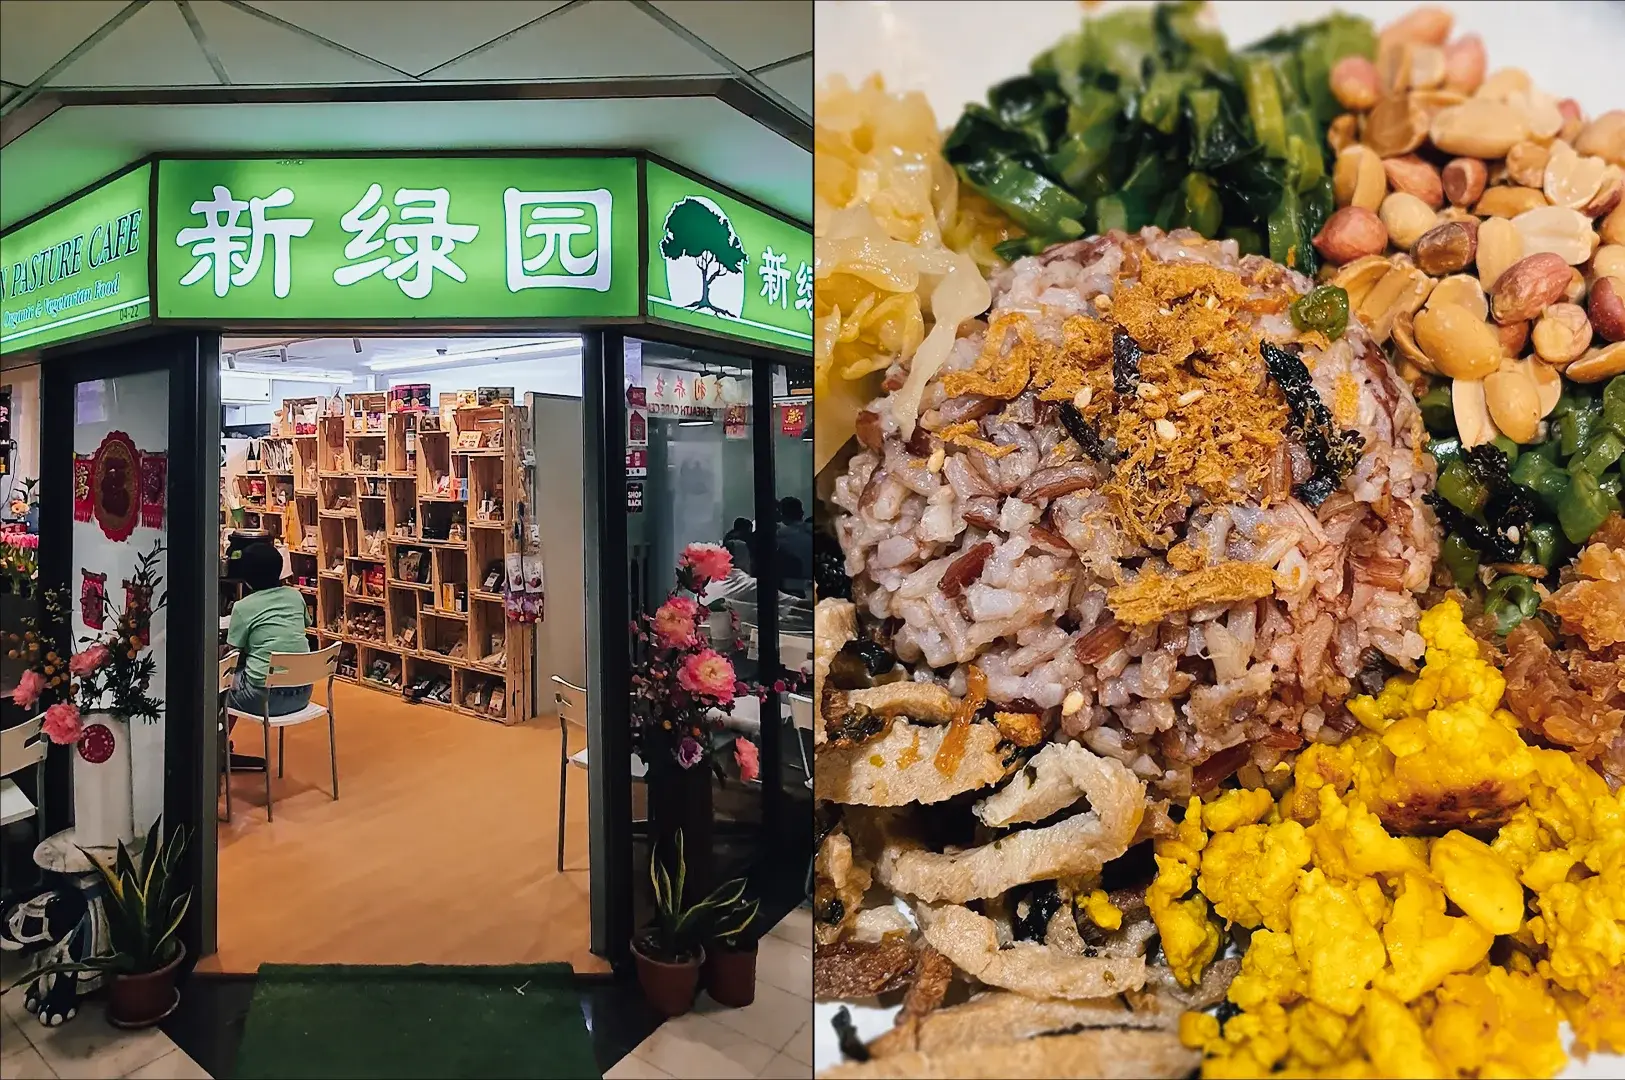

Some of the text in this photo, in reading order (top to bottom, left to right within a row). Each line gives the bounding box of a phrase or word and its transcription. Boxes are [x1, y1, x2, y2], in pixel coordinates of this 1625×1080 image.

[11, 233, 84, 298] PASTURE
[88, 208, 143, 270] CAFE
[175, 181, 614, 300] 新绿园
[3, 271, 121, 329] Organic & Vegetarian Food
[119, 305, 139, 321] 04-22
[627, 491, 642, 499] SHOP
